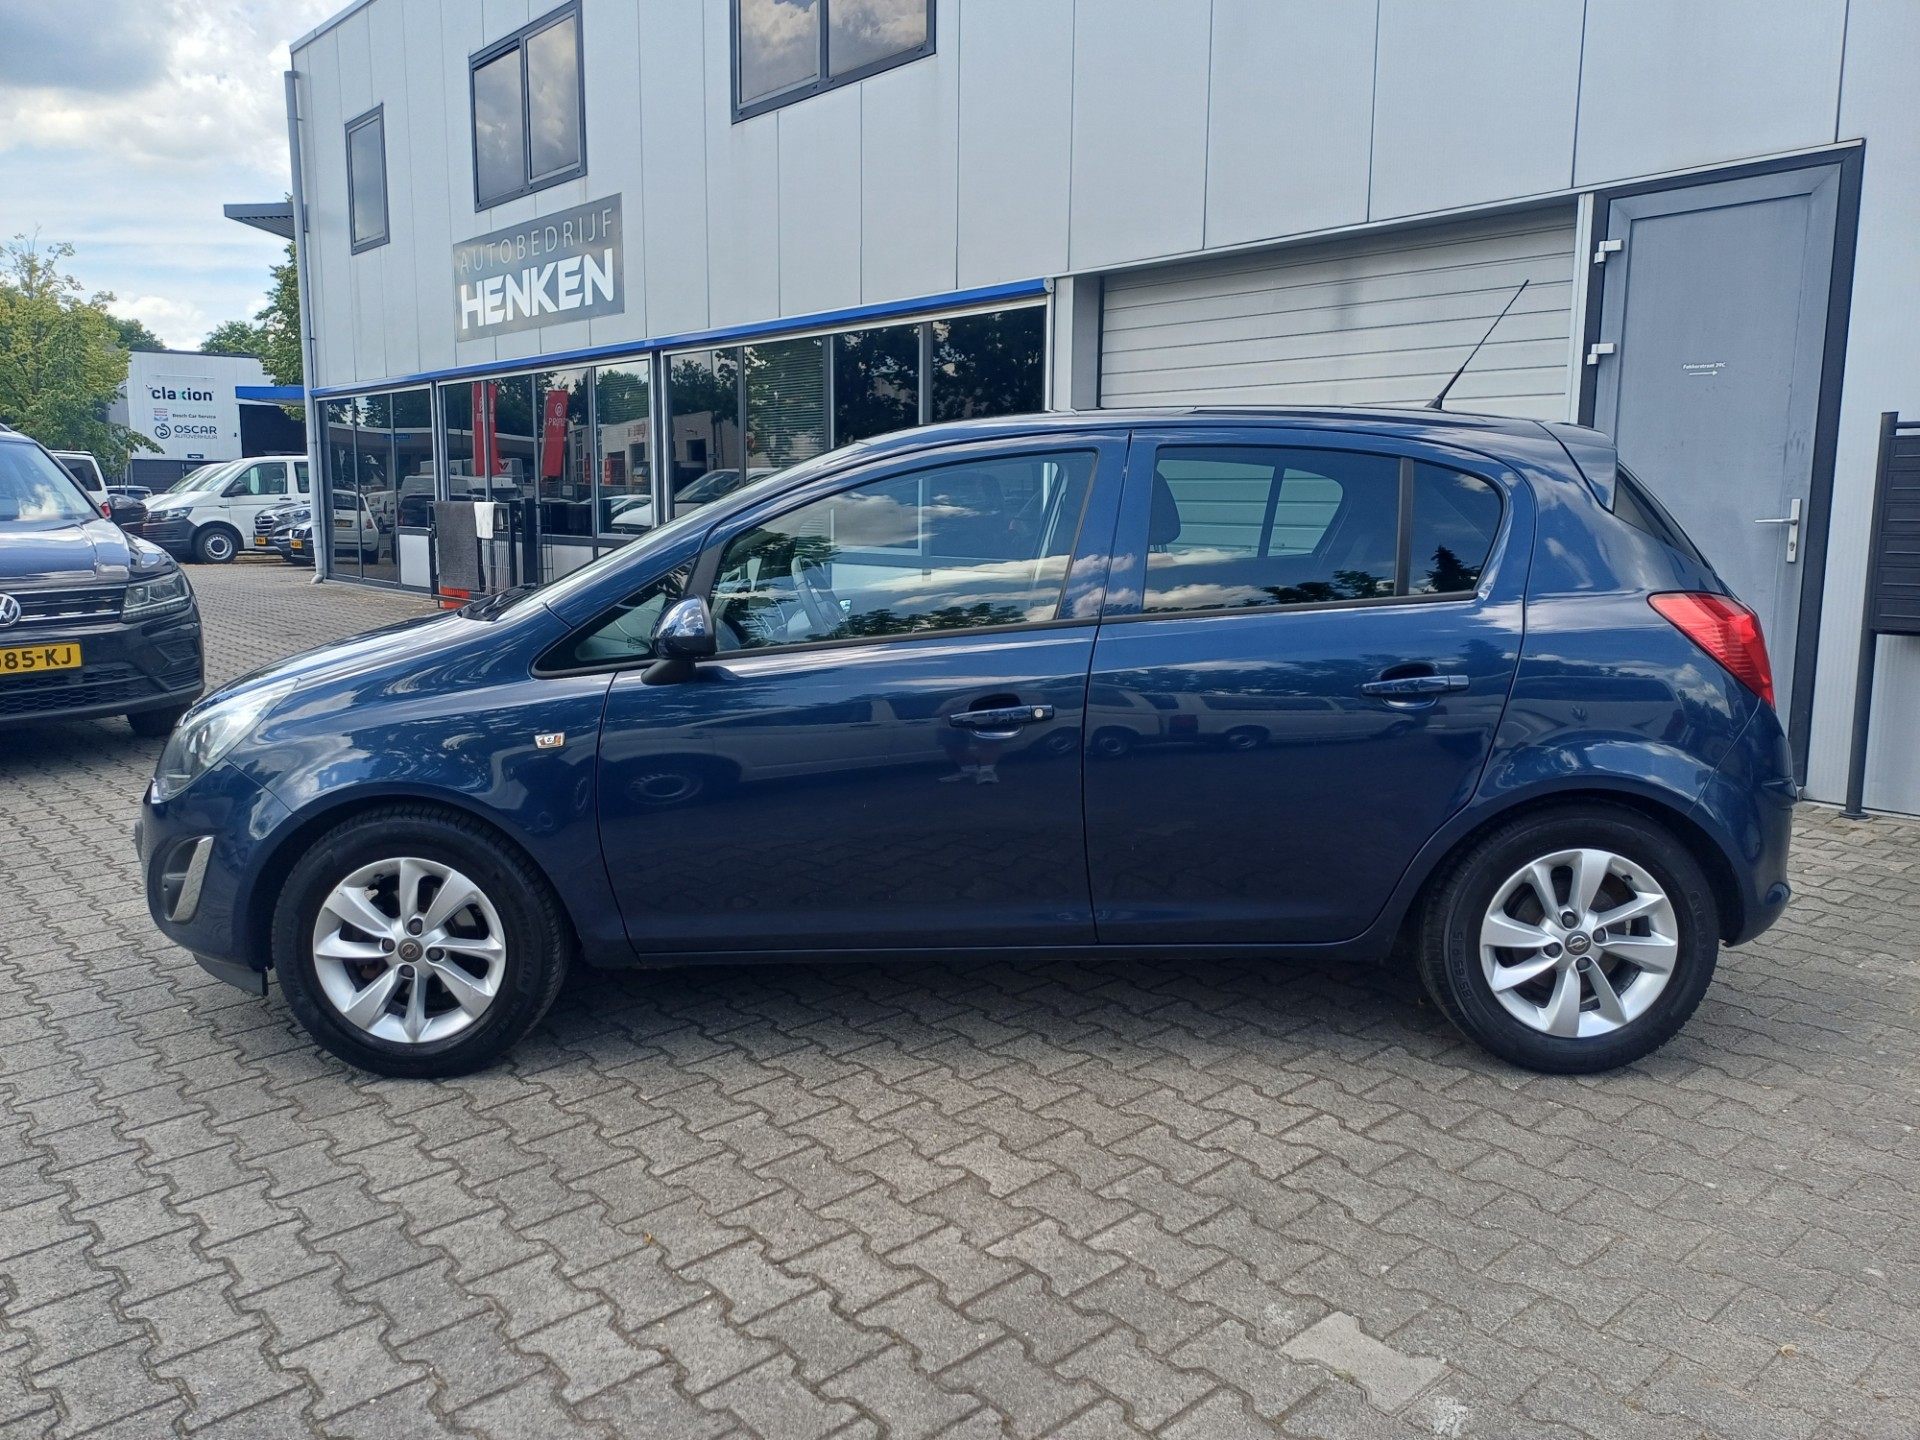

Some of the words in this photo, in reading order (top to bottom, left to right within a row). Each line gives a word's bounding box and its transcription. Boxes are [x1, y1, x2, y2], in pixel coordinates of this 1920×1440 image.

[459, 208, 613, 275] AUTOBEDRIJF
[460, 247, 614, 330] HENKEN
[151, 386, 213, 401] claxion
[174, 425, 217, 434] OSCAR
[0, 647, 72, 669] 85-KJ
